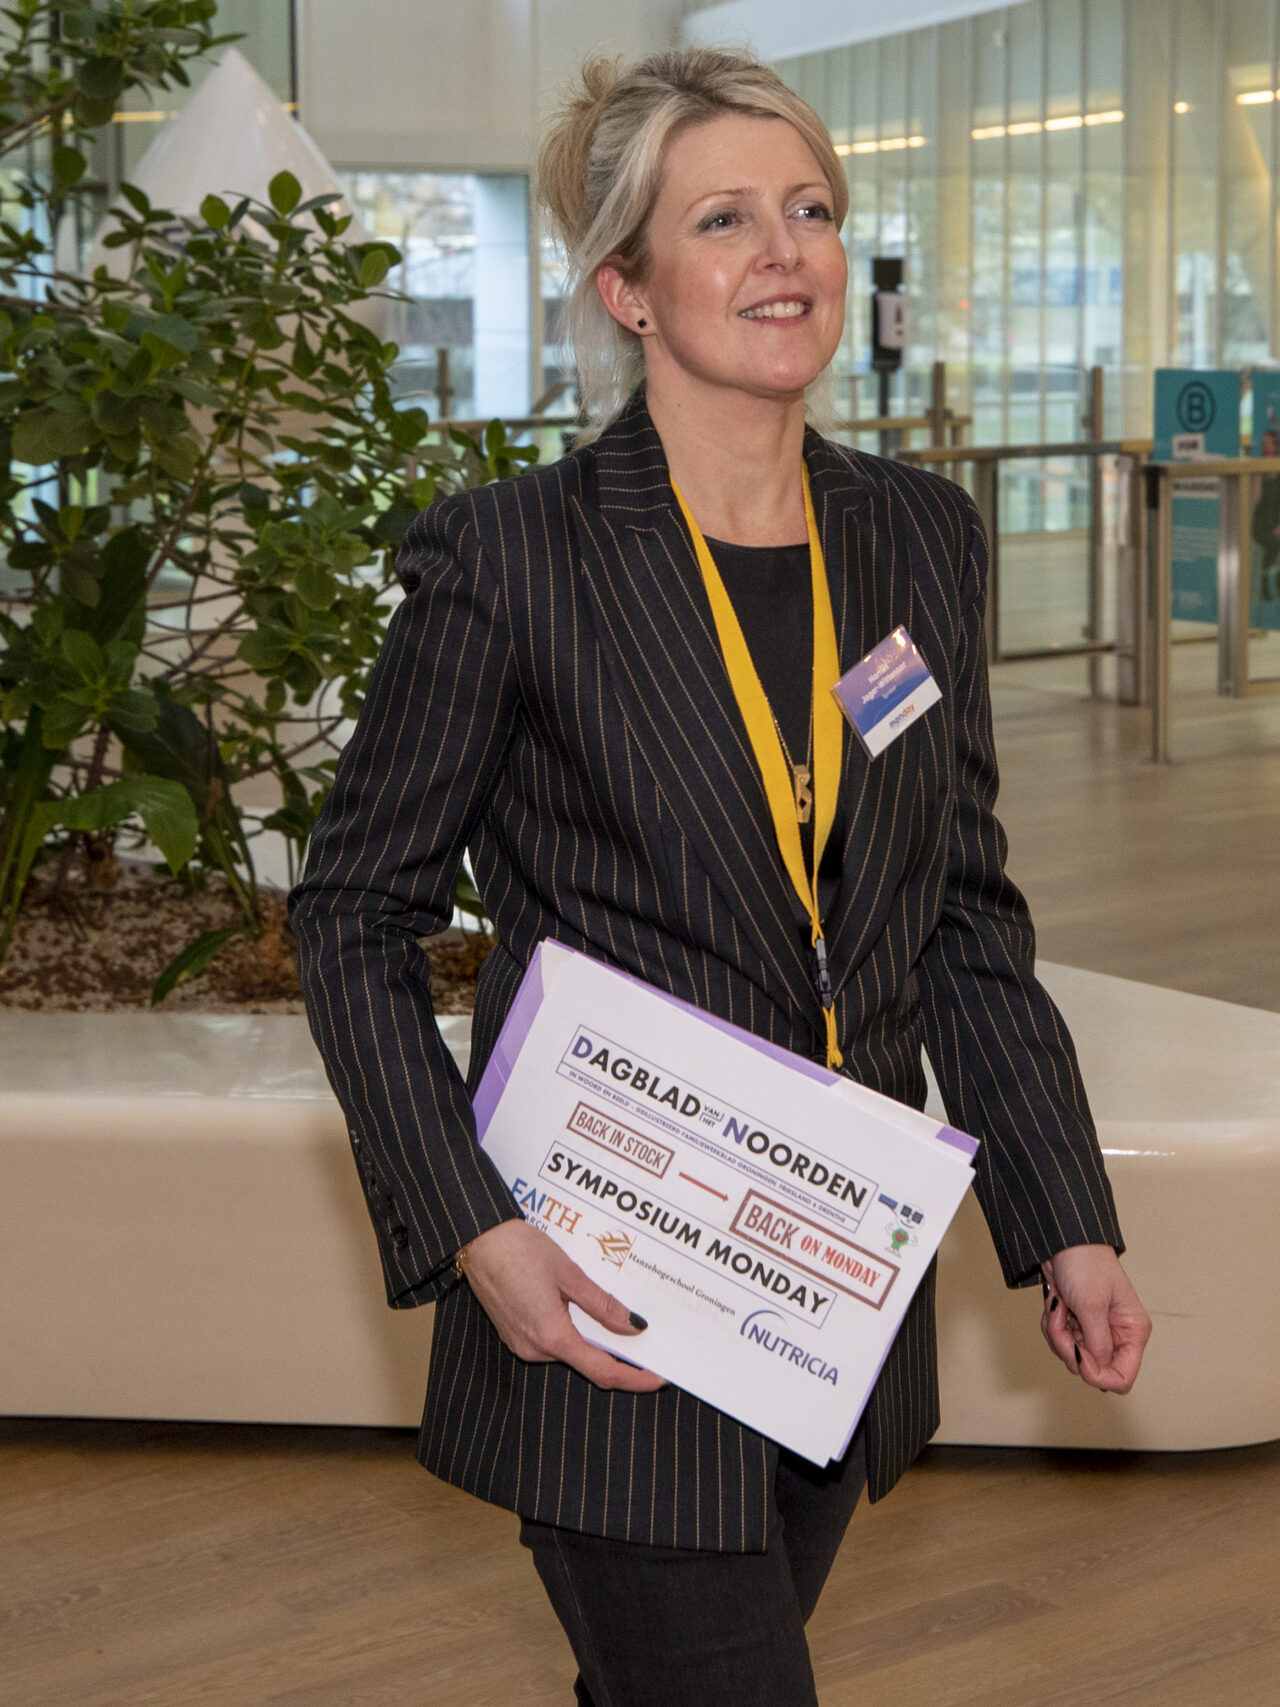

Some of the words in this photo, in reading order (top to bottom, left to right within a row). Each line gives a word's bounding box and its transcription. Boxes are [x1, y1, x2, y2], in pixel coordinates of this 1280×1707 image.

[571, 1035, 700, 1118] DAGBLAD
[703, 1104, 720, 1118] VAN
[575, 1111, 611, 1140] BACK
[608, 1128, 625, 1148] IN
[623, 1137, 665, 1169] STOCK
[577, 1075, 602, 1092] WOORD
[602, 1088, 612, 1097] EN
[612, 1094, 630, 1107] BEELD
[778, 1183, 812, 1205] FRIESLAND
[817, 1204, 846, 1224] DRENTHE
[702, 1117, 716, 1128] HET
[722, 1116, 868, 1209] NOORDEN
[547, 1152, 701, 1249] SYMPOSIUM
[705, 1239, 829, 1314] MONDAY
[743, 1204, 800, 1250] BACK
[800, 1234, 823, 1256] ON
[821, 1249, 881, 1289] MONDAY
[628, 1251, 696, 1294] Hanzehogeschool
[695, 1289, 736, 1317] Groningen
[747, 1323, 839, 1386] NUTRICIA
